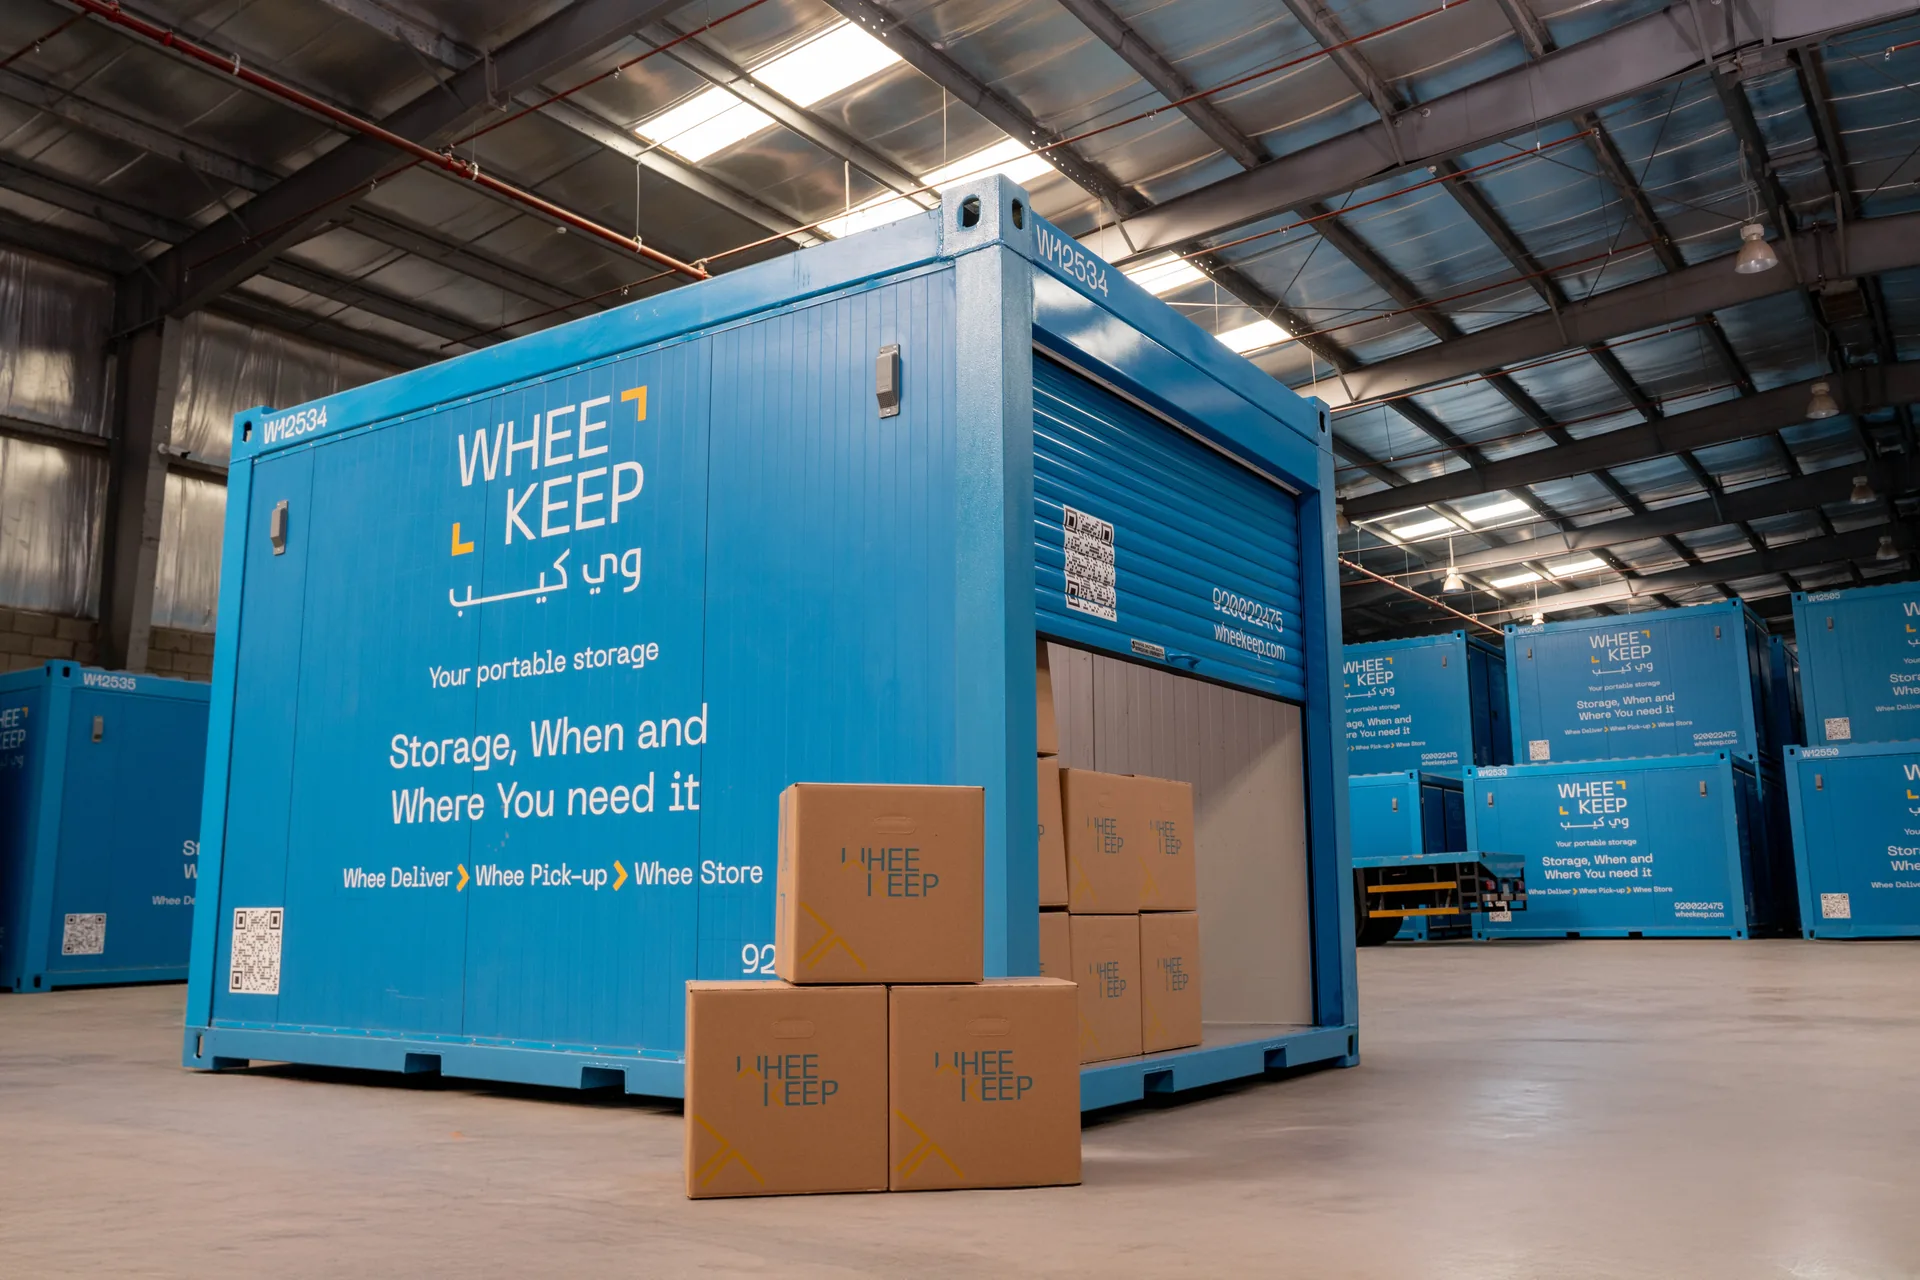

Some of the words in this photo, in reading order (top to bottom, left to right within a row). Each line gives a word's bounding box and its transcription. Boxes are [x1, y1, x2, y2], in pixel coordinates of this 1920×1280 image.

[1036, 224, 1108, 298] W12534
[263, 405, 328, 444] W12534
[458, 395, 610, 491] WHEE
[505, 457, 644, 544] KEEP
[582, 548, 641, 595] وي
[1213, 588, 1283, 636] 920022475
[1214, 622, 1285, 660] wheekeep.com
[1590, 632, 1640, 649] WHEE
[430, 666, 470, 688] Your
[477, 650, 566, 688] portable
[574, 642, 658, 670] storage
[1608, 645, 1651, 661] KEEP
[1343, 658, 1384, 674] WHEE
[84, 673, 136, 690] W12535
[1358, 671, 1394, 686] KEEP
[1604, 682, 1633, 691] portable
[1893, 686, 1920, 695] Whe
[1577, 698, 1620, 709] Storage,
[1623, 696, 1652, 704] When
[1655, 692, 1674, 702] and
[1579, 712, 1611, 720] Where
[1614, 709, 1633, 719] You
[1636, 706, 1662, 715] need
[1666, 705, 1674, 713] it
[1368, 718, 1392, 726] When
[1394, 715, 1411, 724] and
[1378, 727, 1400, 736] need
[390, 734, 516, 771] Storage,
[531, 716, 623, 757] When
[638, 703, 707, 749] and
[392, 787, 484, 824] Where
[497, 782, 554, 818] You
[568, 772, 654, 816] need
[669, 771, 699, 811] it
[1558, 782, 1614, 798] WHEE
[1579, 798, 1627, 814] KEEP
[842, 848, 920, 872] WHEE
[1542, 857, 1590, 867] Storage,
[1594, 855, 1626, 864] When
[1630, 853, 1653, 863] and
[1891, 860, 1920, 870] Whe
[344, 868, 386, 888] Whee
[391, 866, 453, 887] Deliver
[476, 864, 524, 886] Whee
[531, 863, 607, 890] Pick-up
[635, 861, 692, 885] Whee
[701, 860, 762, 884] Store
[1545, 870, 1580, 879] Where
[1584, 869, 1605, 878] You
[1609, 868, 1638, 878] need
[1642, 868, 1652, 877] it
[868, 874, 939, 898] KEEP
[736, 1054, 818, 1081] WHEE
[935, 1050, 1014, 1077] WHEE
[764, 1080, 839, 1107] KEEP
[961, 1076, 1033, 1102] KEEP
